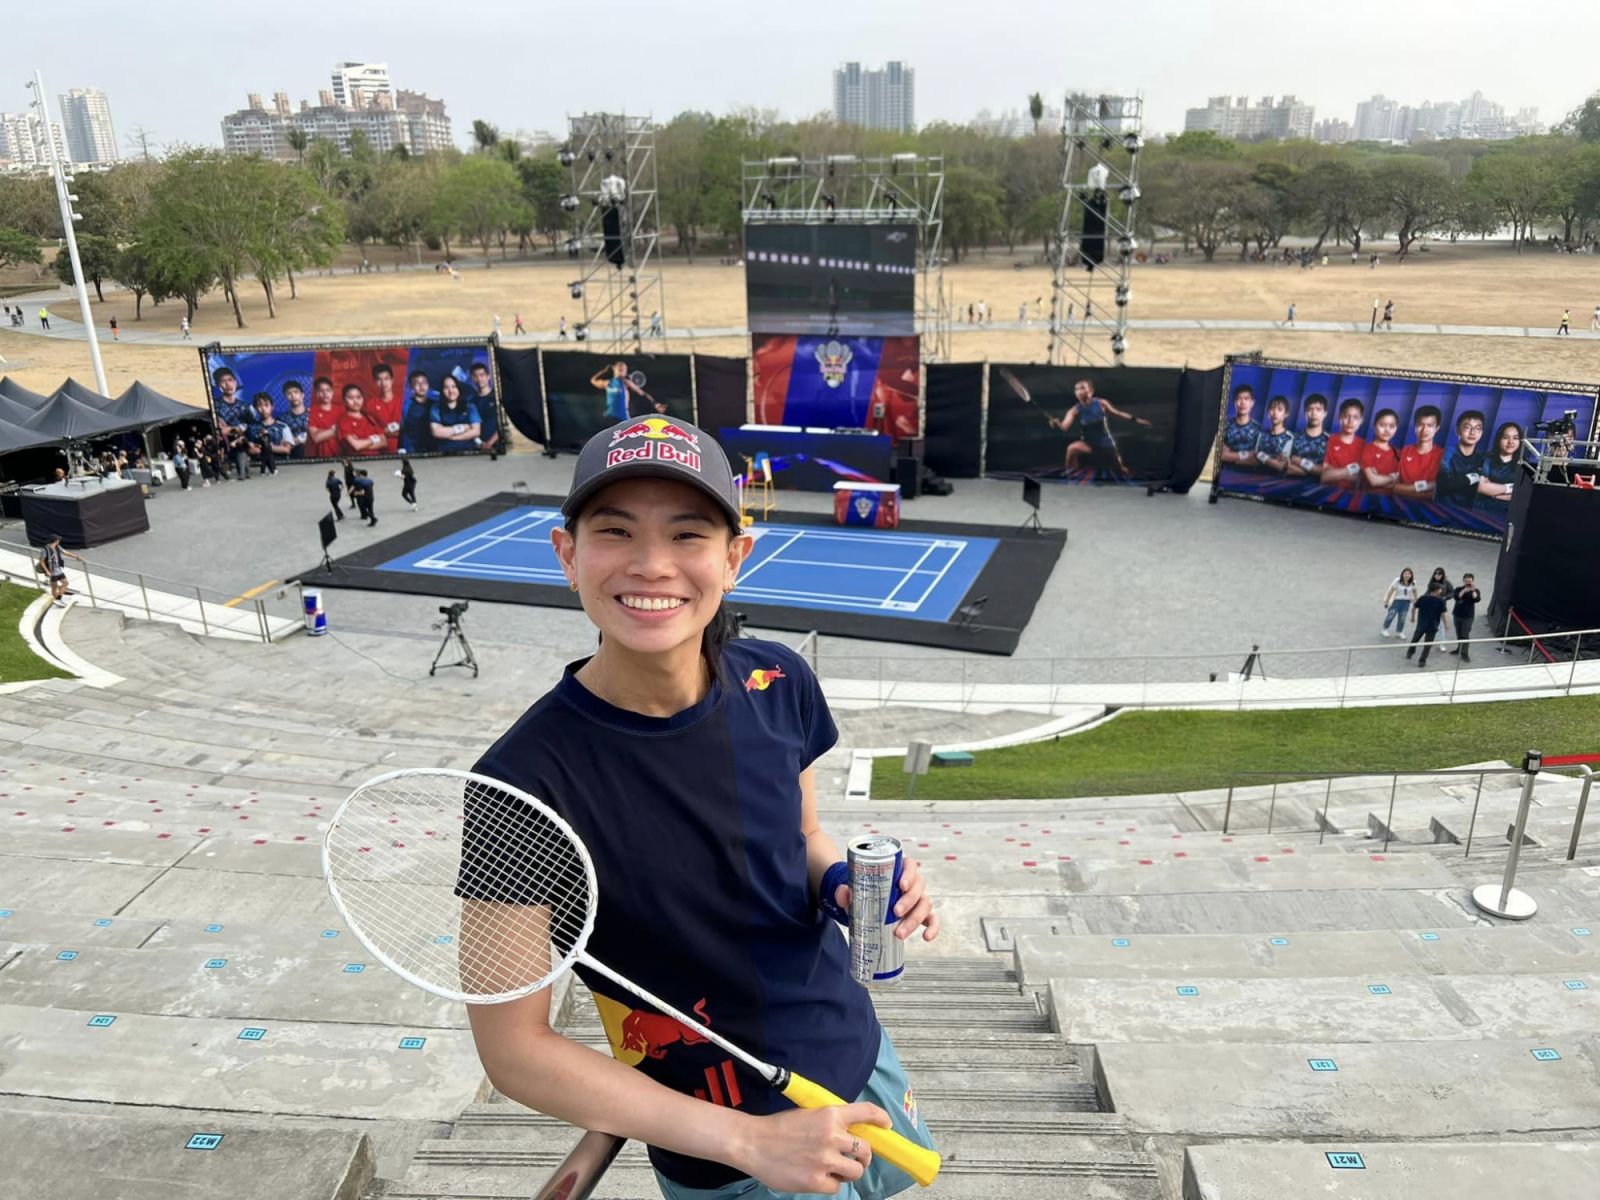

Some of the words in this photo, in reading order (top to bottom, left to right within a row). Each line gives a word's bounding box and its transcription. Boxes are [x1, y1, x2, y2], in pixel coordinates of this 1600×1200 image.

[607, 441, 653, 468] Red
[658, 442, 701, 472] Bull
[192, 1137, 218, 1146] M22
[1333, 1156, 1358, 1165] M21
